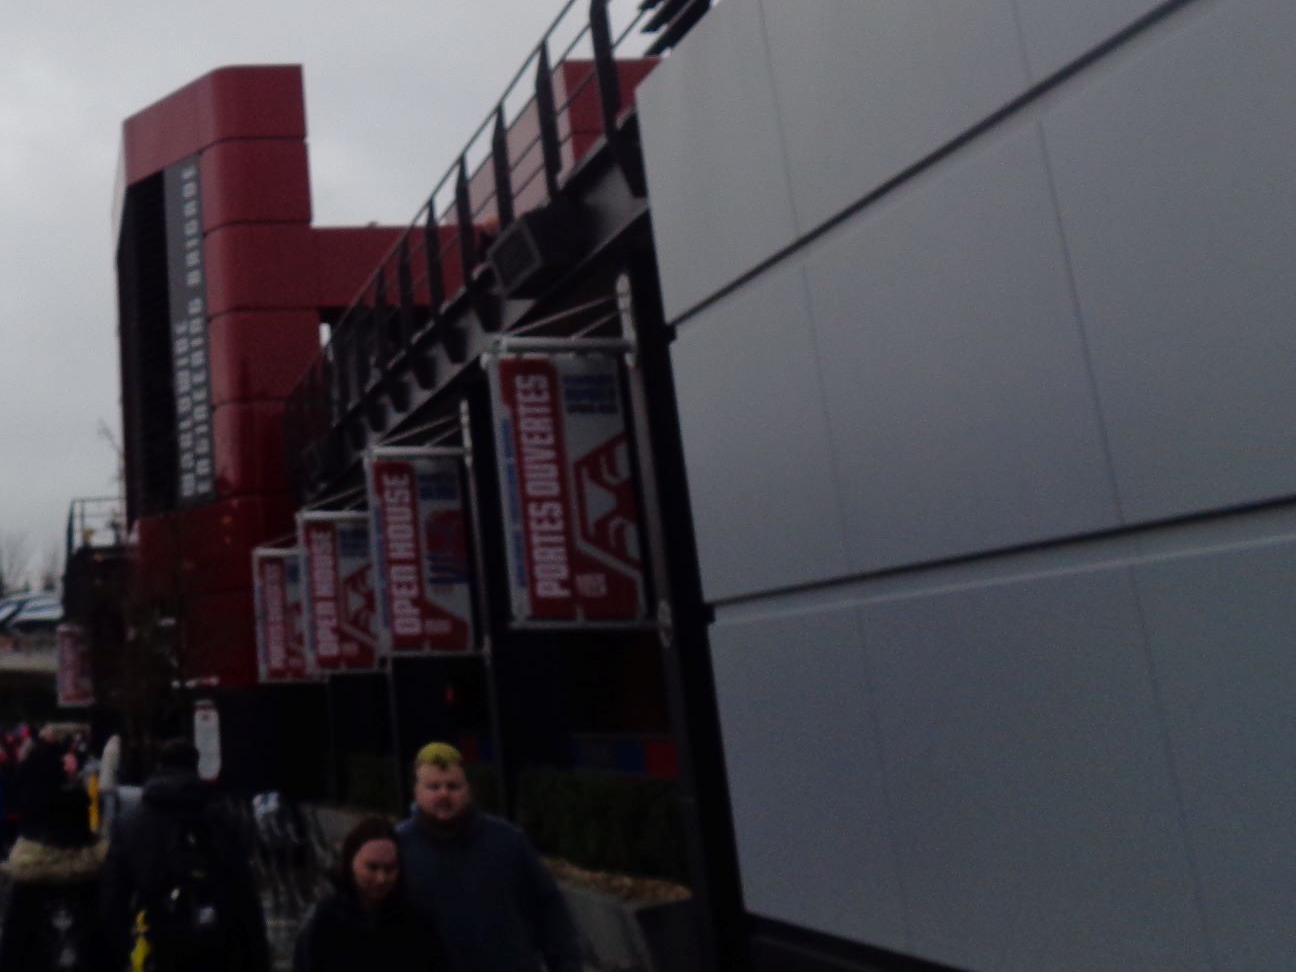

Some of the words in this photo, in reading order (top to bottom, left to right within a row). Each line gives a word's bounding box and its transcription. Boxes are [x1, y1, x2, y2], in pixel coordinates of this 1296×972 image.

[515, 375, 559, 497] OUVERTES
[382, 473, 416, 559] HOUSE
[527, 501, 572, 599] PORTES
[390, 565, 422, 636] OPEN
